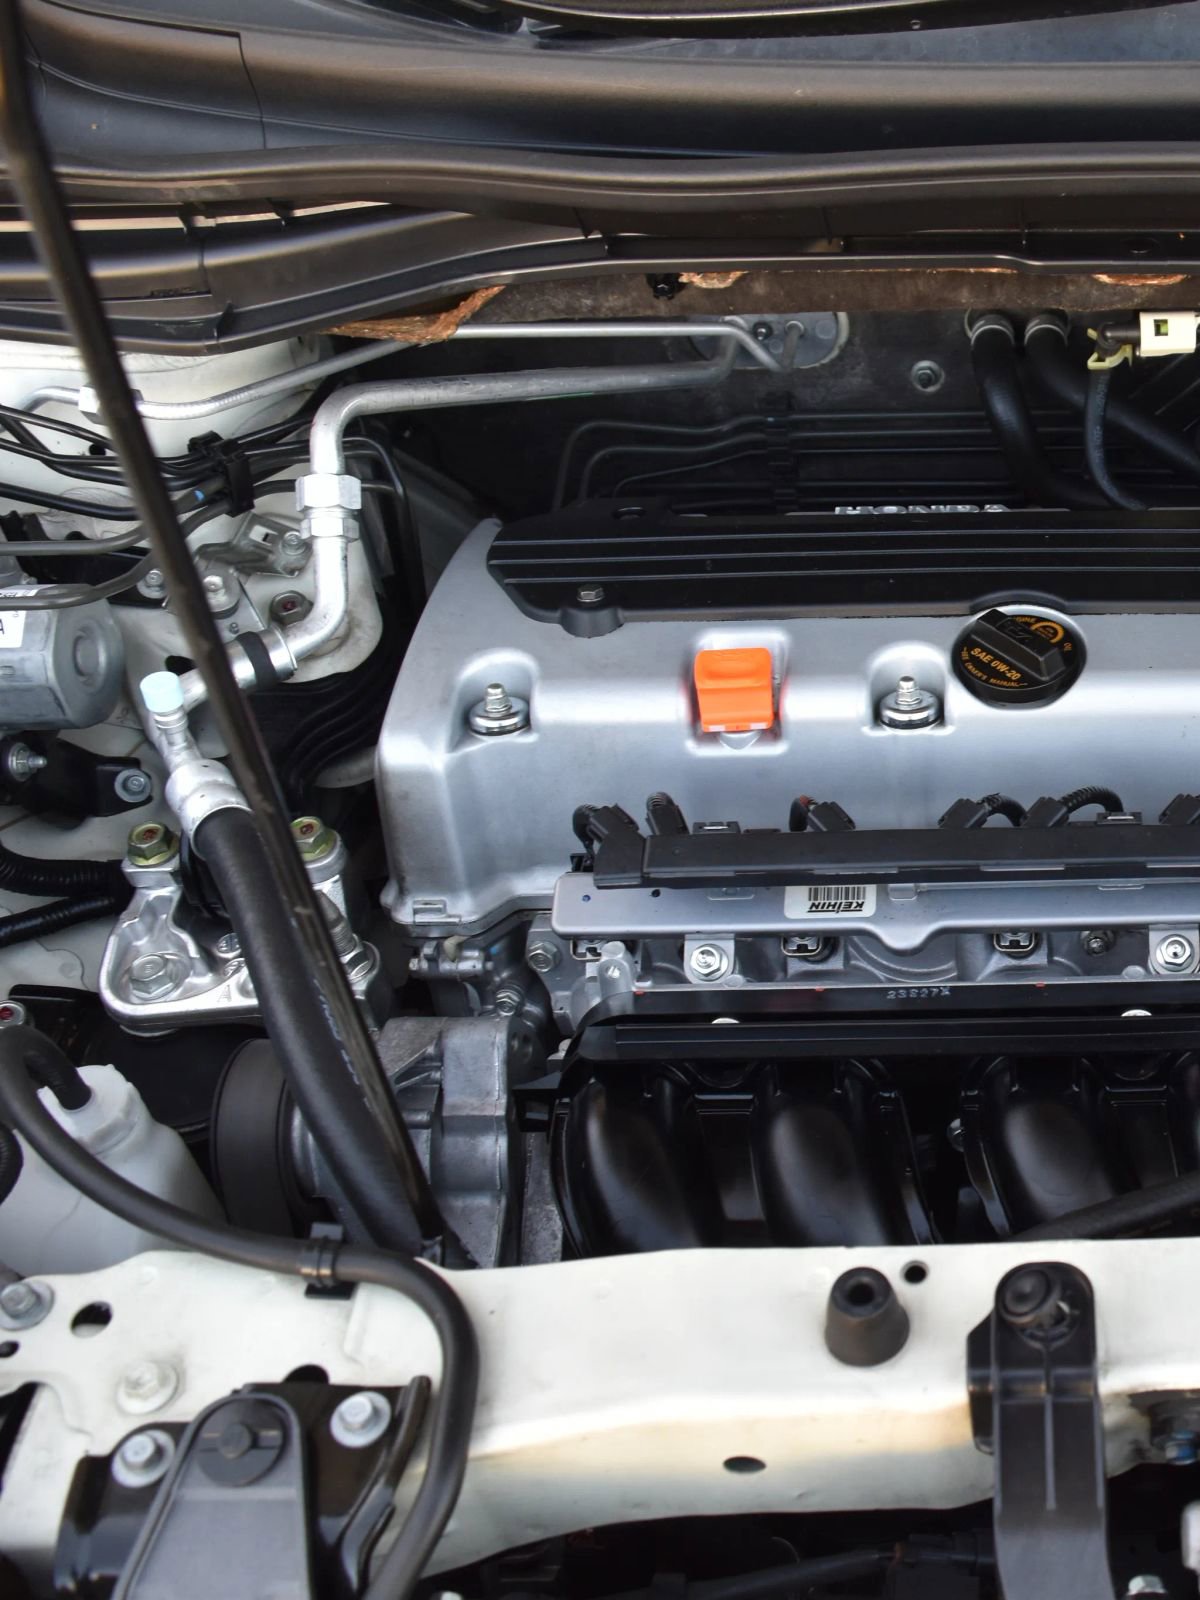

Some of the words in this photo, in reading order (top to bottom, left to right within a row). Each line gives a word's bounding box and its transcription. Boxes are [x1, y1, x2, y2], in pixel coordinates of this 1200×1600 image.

[970, 647, 994, 664] SAE
[990, 660, 1021, 681] 0W-20
[808, 901, 865, 914] KEIHIN
